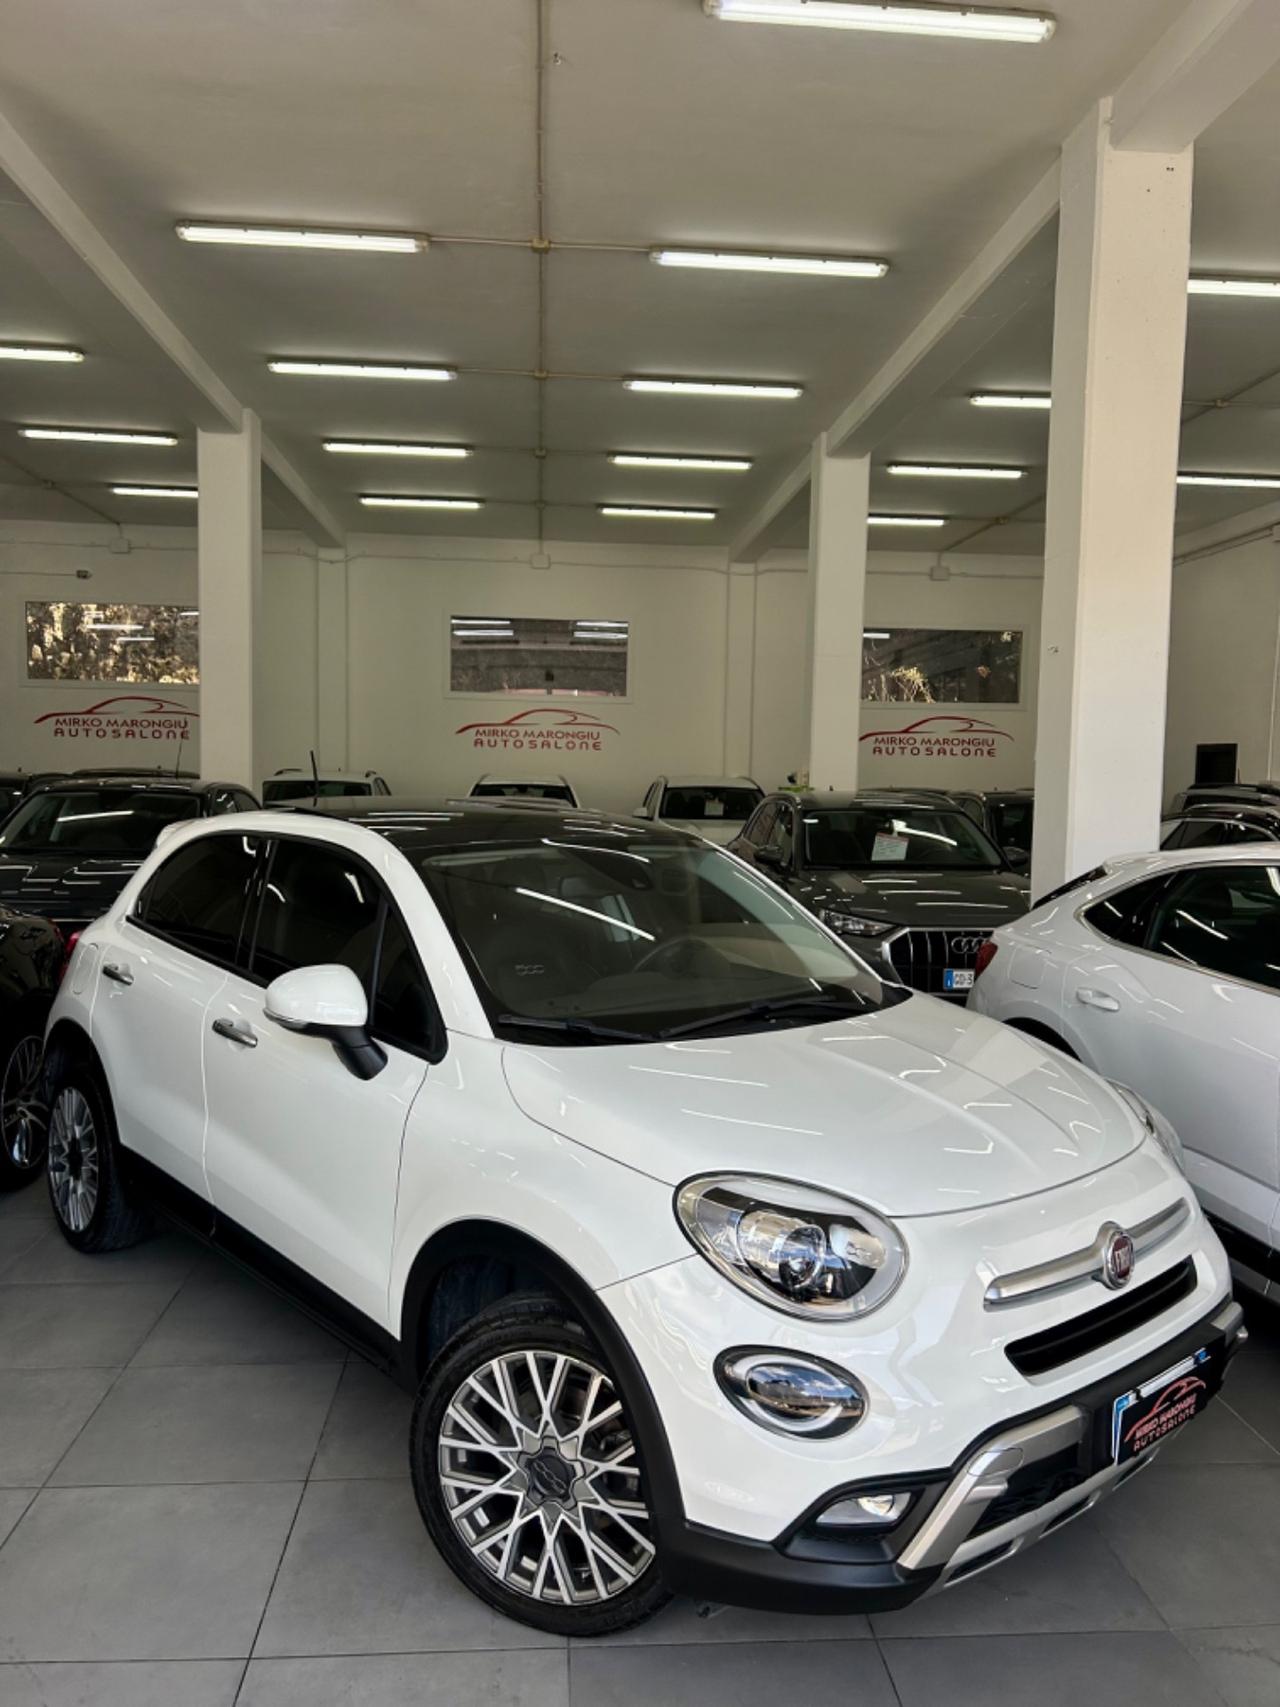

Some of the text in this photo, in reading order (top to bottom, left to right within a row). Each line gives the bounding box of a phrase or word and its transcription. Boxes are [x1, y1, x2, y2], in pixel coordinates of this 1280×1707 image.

[54, 717, 188, 729] MIRKO MARONGIU
[53, 728, 190, 740] AUTOSALONE
[475, 728, 600, 740] MIRKO MARONGIU
[473, 738, 602, 750] AUTOSALONE
[874, 736, 995, 747] MIRKO MARONGIU
[872, 746, 997, 757] AUTOSALONE
